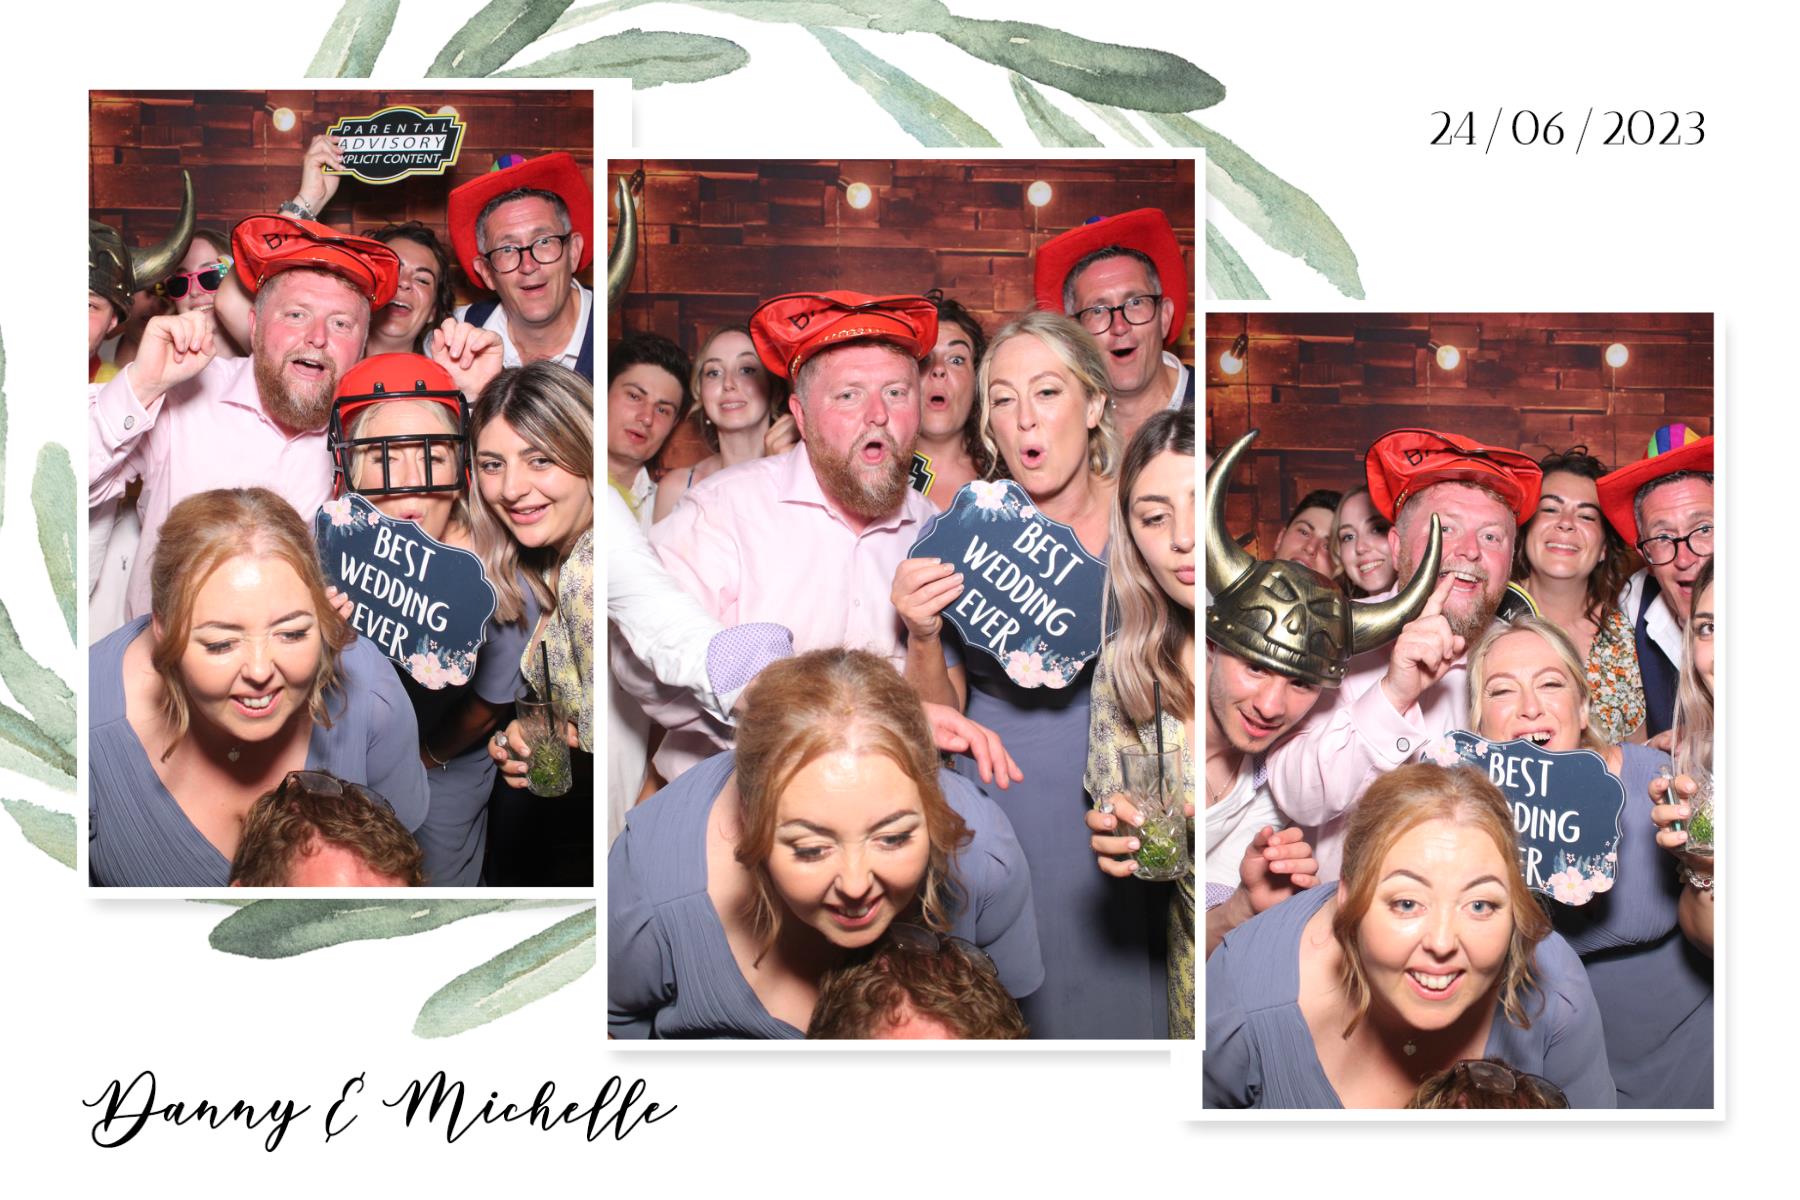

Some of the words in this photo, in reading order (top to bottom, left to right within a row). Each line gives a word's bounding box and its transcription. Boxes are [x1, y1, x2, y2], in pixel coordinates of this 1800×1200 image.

[339, 136, 445, 150] ADVISORY
[342, 122, 448, 135] PARENTAL
[340, 153, 382, 164] XPLICIT
[383, 153, 441, 164] CONTENT
[374, 525, 436, 582] BEST
[1013, 521, 1084, 586] BEST
[341, 551, 450, 632] WEDDING
[963, 535, 1077, 637] WEDDING
[351, 602, 409, 659] EVER
[955, 588, 1020, 653] EVER
[1487, 752, 1554, 798] BEST
[1505, 800, 1581, 843] DING
